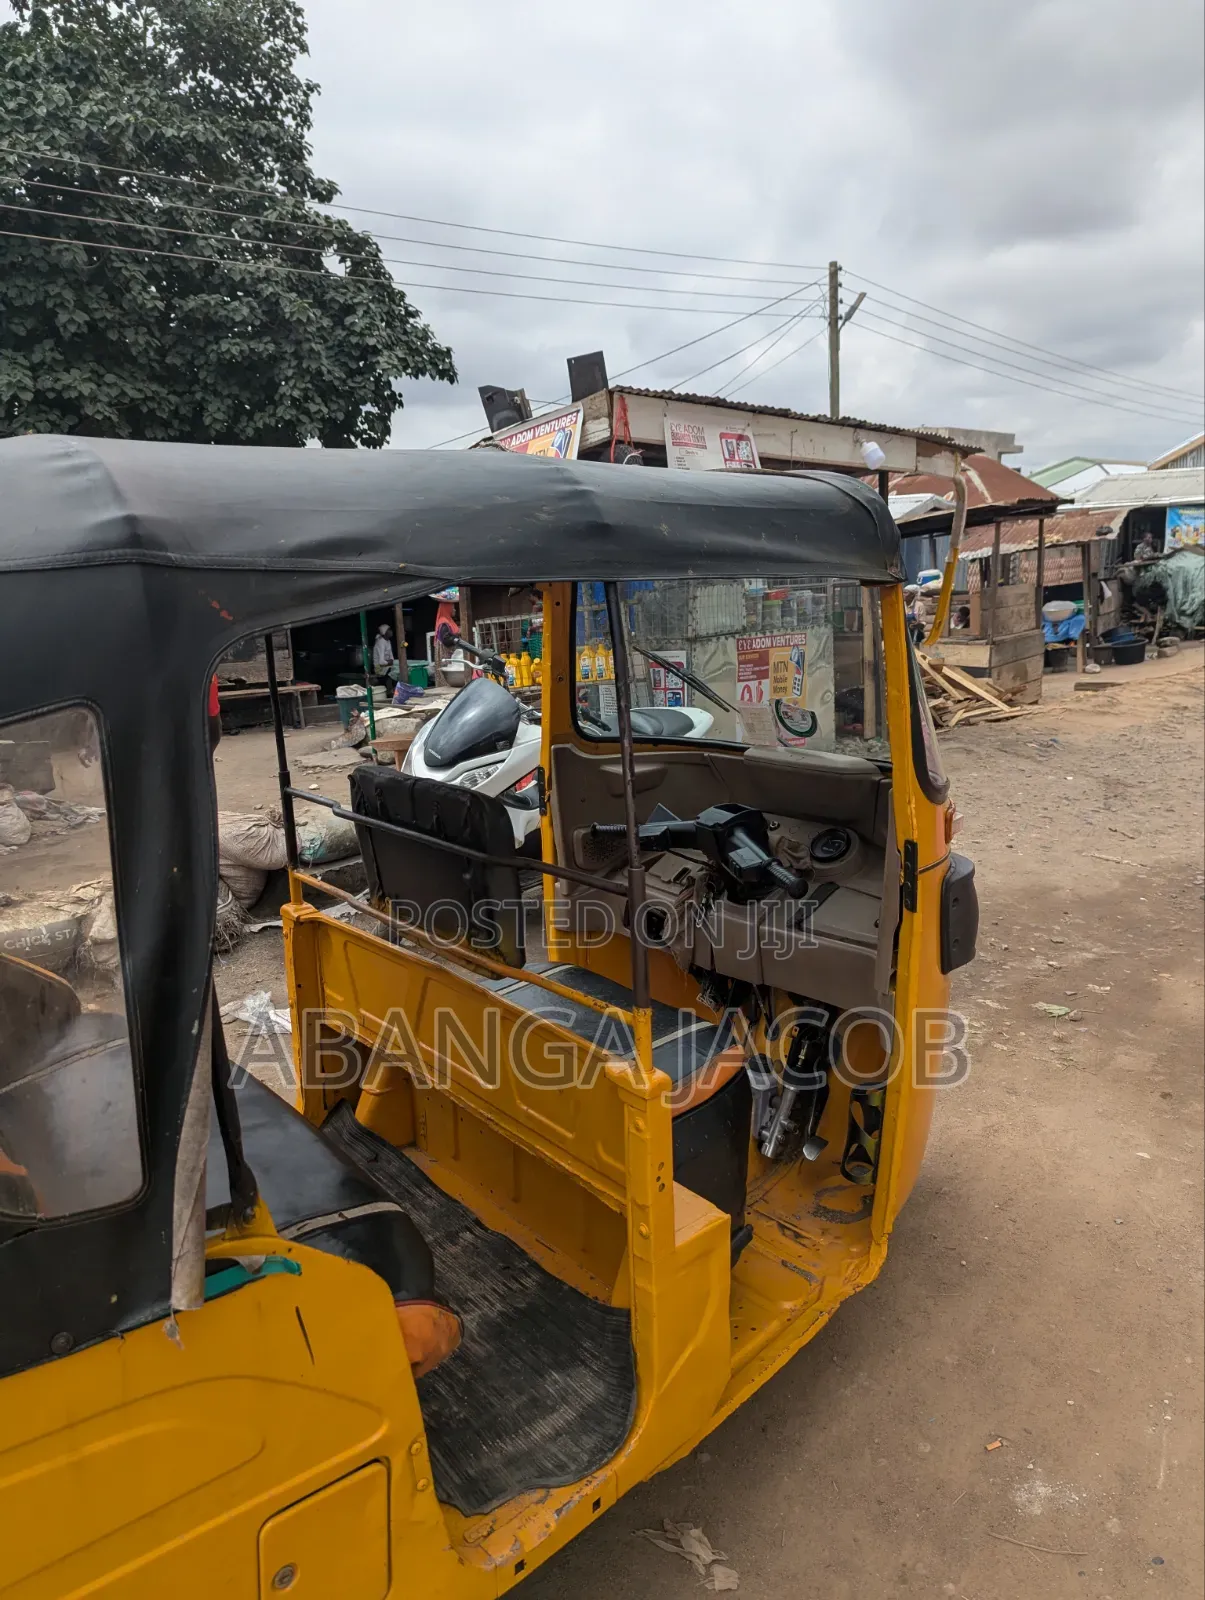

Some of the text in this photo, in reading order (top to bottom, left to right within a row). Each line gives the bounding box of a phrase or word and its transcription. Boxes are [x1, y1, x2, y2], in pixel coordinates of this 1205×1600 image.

[510, 428, 534, 447] ADOM
[535, 413, 577, 438] VENTURES
[684, 424, 705, 435] ADOM
[752, 637, 772, 649] ADOM
[772, 634, 806, 646] VENTURES
[773, 661, 789, 674] MTN
[773, 685, 788, 694] Money
